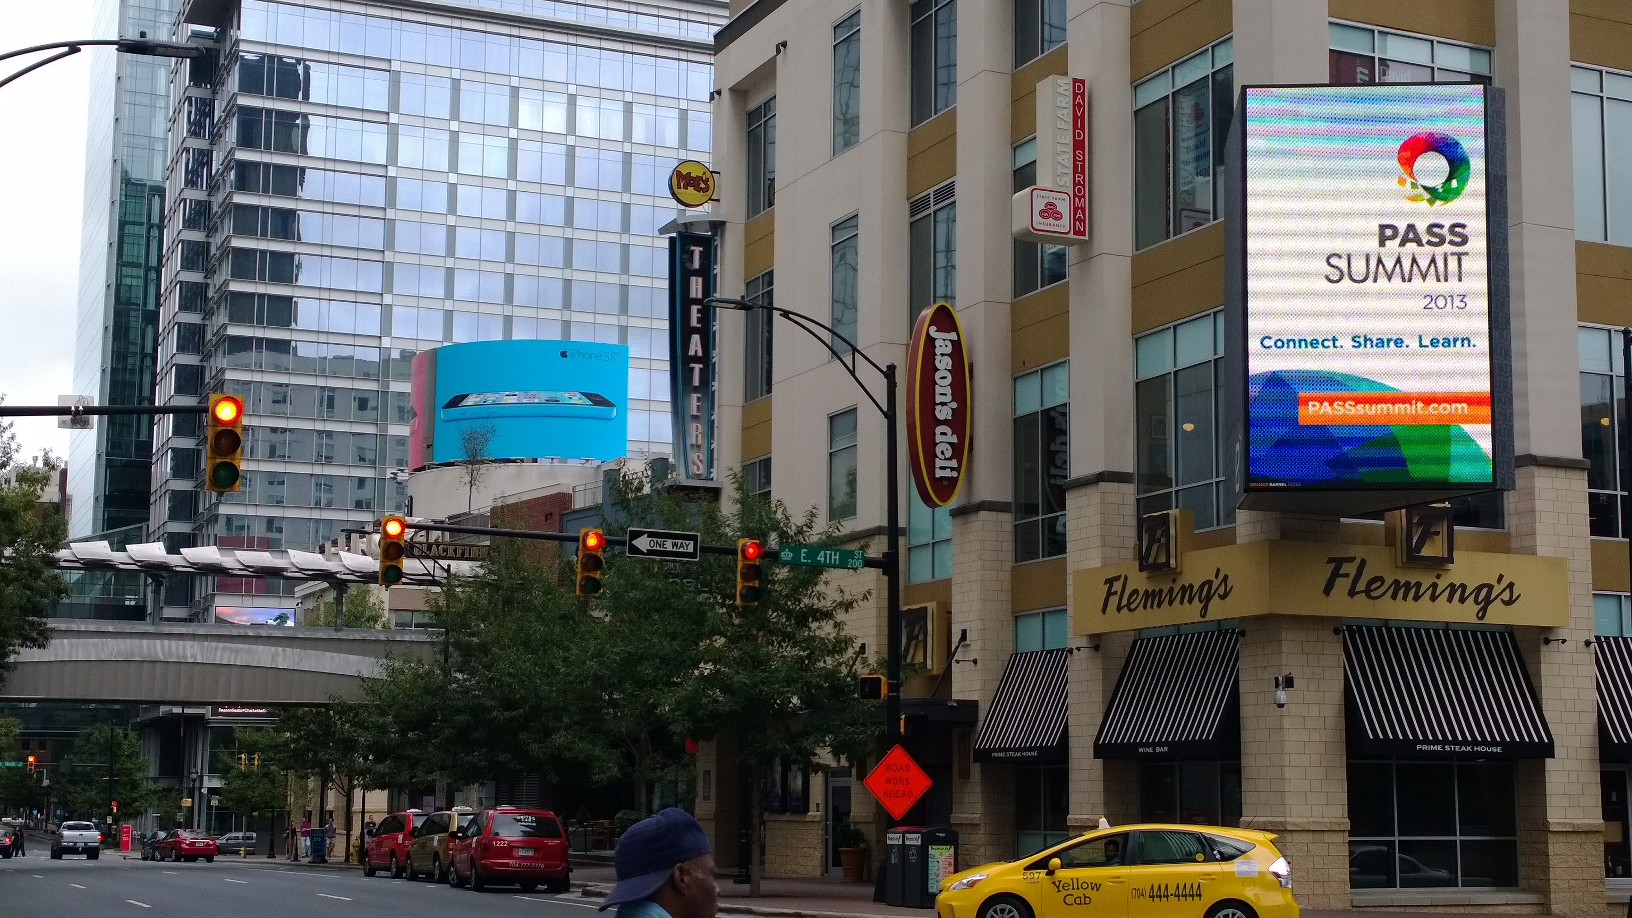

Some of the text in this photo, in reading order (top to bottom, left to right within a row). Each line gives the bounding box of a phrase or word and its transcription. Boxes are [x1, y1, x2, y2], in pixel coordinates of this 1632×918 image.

[1057, 79, 1070, 188] STATE FARM
[1075, 83, 1084, 232] DAVID STROMAN
[1378, 222, 1469, 248] PASS
[1324, 251, 1469, 284] SUMMIT
[1422, 294, 1468, 310] 2013
[1260, 334, 1477, 349] Connect. Share. Learn.
[570, 349, 603, 361] iPhone
[689, 245, 704, 476] THEATERS
[928, 325, 958, 479] Jason's deli
[1308, 400, 1469, 416] PASSsummit.com
[648, 539, 691, 551] ONE WAY
[800, 550, 840, 565] E. 4TH
[853, 551, 863, 560] ST
[847, 559, 863, 569] 200
[1101, 566, 1234, 619] Fleming's
[1322, 556, 1522, 621] Fleming's
[1474, 745, 1503, 753] HOUSE
[885, 763, 911, 772] ROAD
[885, 776, 911, 785] WORK
[882, 789, 914, 798] AHEAD
[1022, 871, 1041, 880] 597
[1051, 877, 1102, 893] Yellow
[1130, 882, 1203, 903] (704) 444-4444
[1063, 894, 1092, 906] Cab
